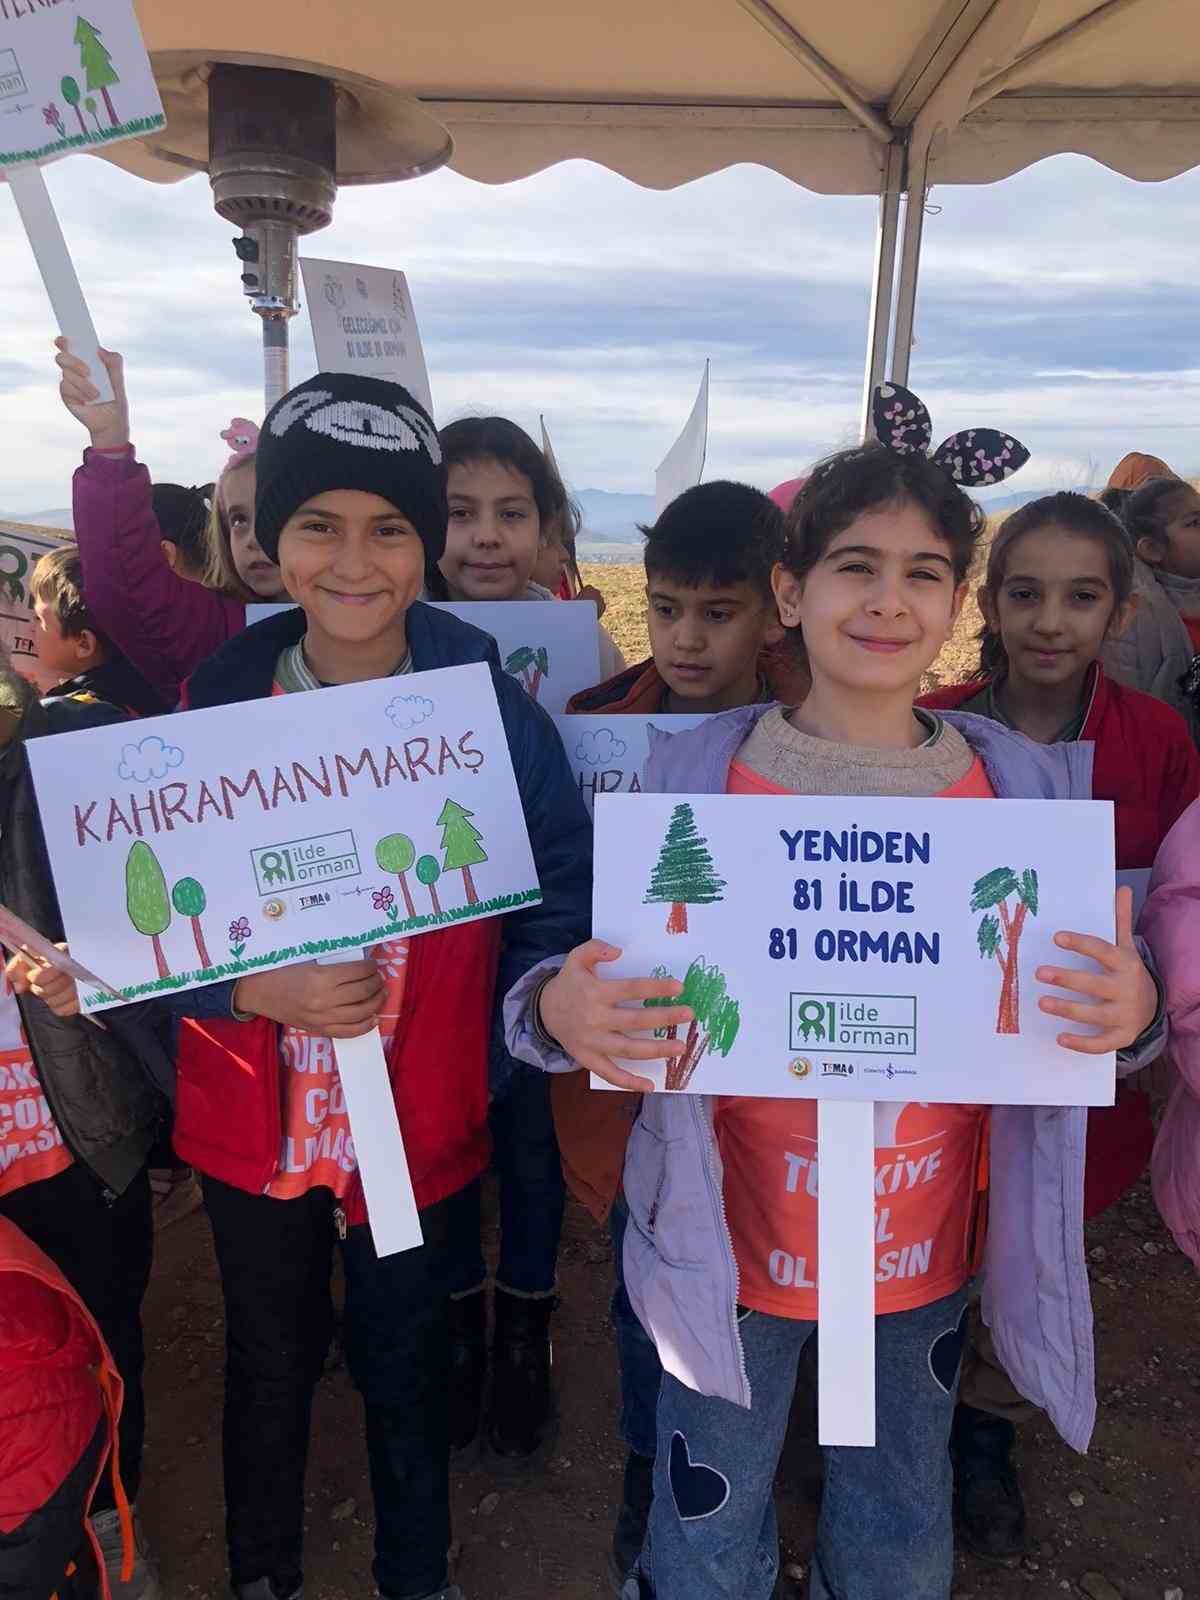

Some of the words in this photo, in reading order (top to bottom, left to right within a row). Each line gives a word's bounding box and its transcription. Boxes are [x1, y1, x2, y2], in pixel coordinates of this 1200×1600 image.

[74, 730, 485, 847] KAHRAMANMARAŞ
[576, 769, 642, 807] HRA
[293, 843, 326, 862] ilde
[779, 823, 930, 864] YENİDEN
[297, 858, 355, 881] orman
[299, 892, 324, 908] TEMA
[793, 878, 822, 911] 81
[839, 872, 915, 913] İLDE
[768, 928, 798, 960] 81
[814, 928, 940, 965] ORMAN
[839, 1002, 879, 1022] ilde
[839, 1029, 910, 1046] orman
[822, 1062, 848, 1074] TEMA
[768, 1239, 933, 1289] OLSIN
